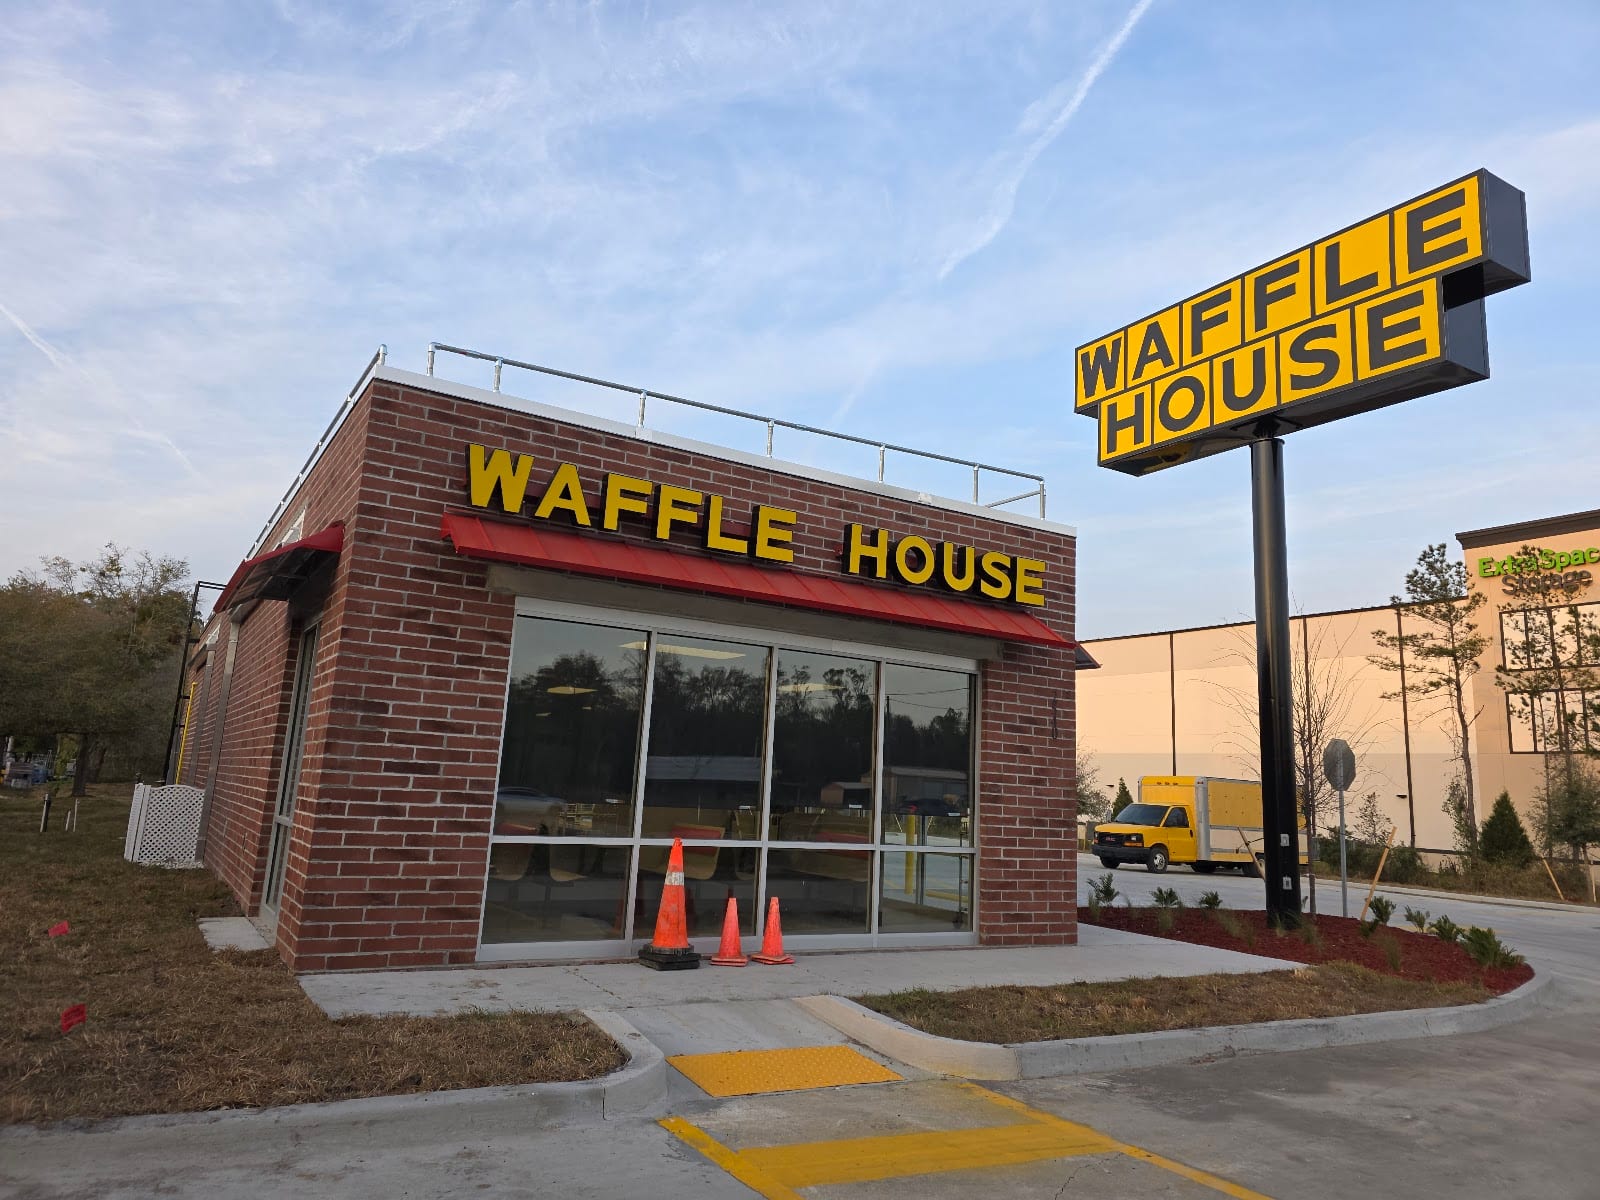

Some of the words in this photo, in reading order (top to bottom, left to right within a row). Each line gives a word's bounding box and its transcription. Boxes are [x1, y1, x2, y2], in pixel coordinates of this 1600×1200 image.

[1080, 187, 1469, 399] WAFFLE
[1106, 289, 1427, 454] HOUSE
[467, 442, 797, 563] WAFFLE
[845, 522, 1046, 607] HOUSE
[1478, 555, 1538, 577] Extra
[1501, 570, 1593, 595] Storage
